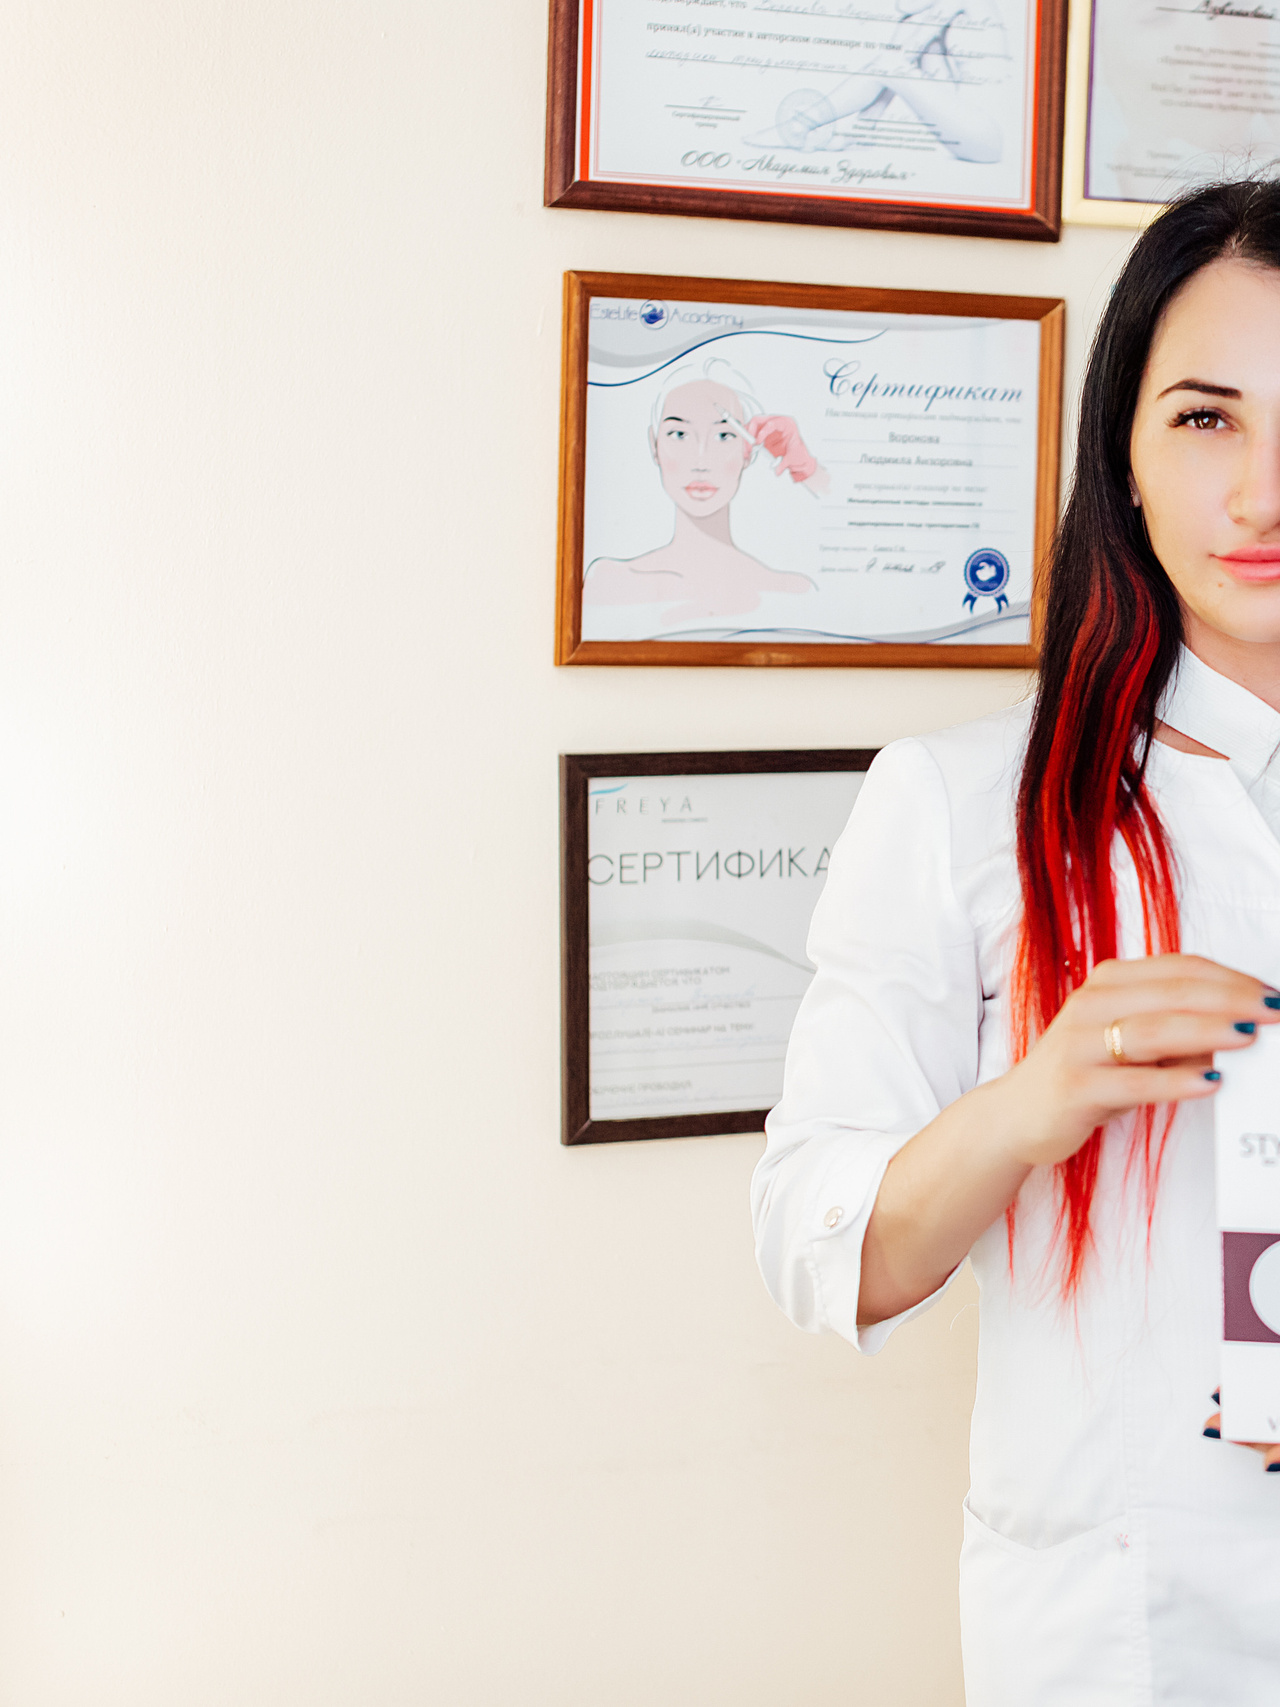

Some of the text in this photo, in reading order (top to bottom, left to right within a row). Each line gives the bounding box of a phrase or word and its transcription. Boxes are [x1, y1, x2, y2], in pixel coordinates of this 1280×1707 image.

[680, 149, 733, 169] ООО
[668, 307, 745, 329] Academy
[822, 356, 1024, 413] Сертификат
[594, 795, 694, 816] FREYA
